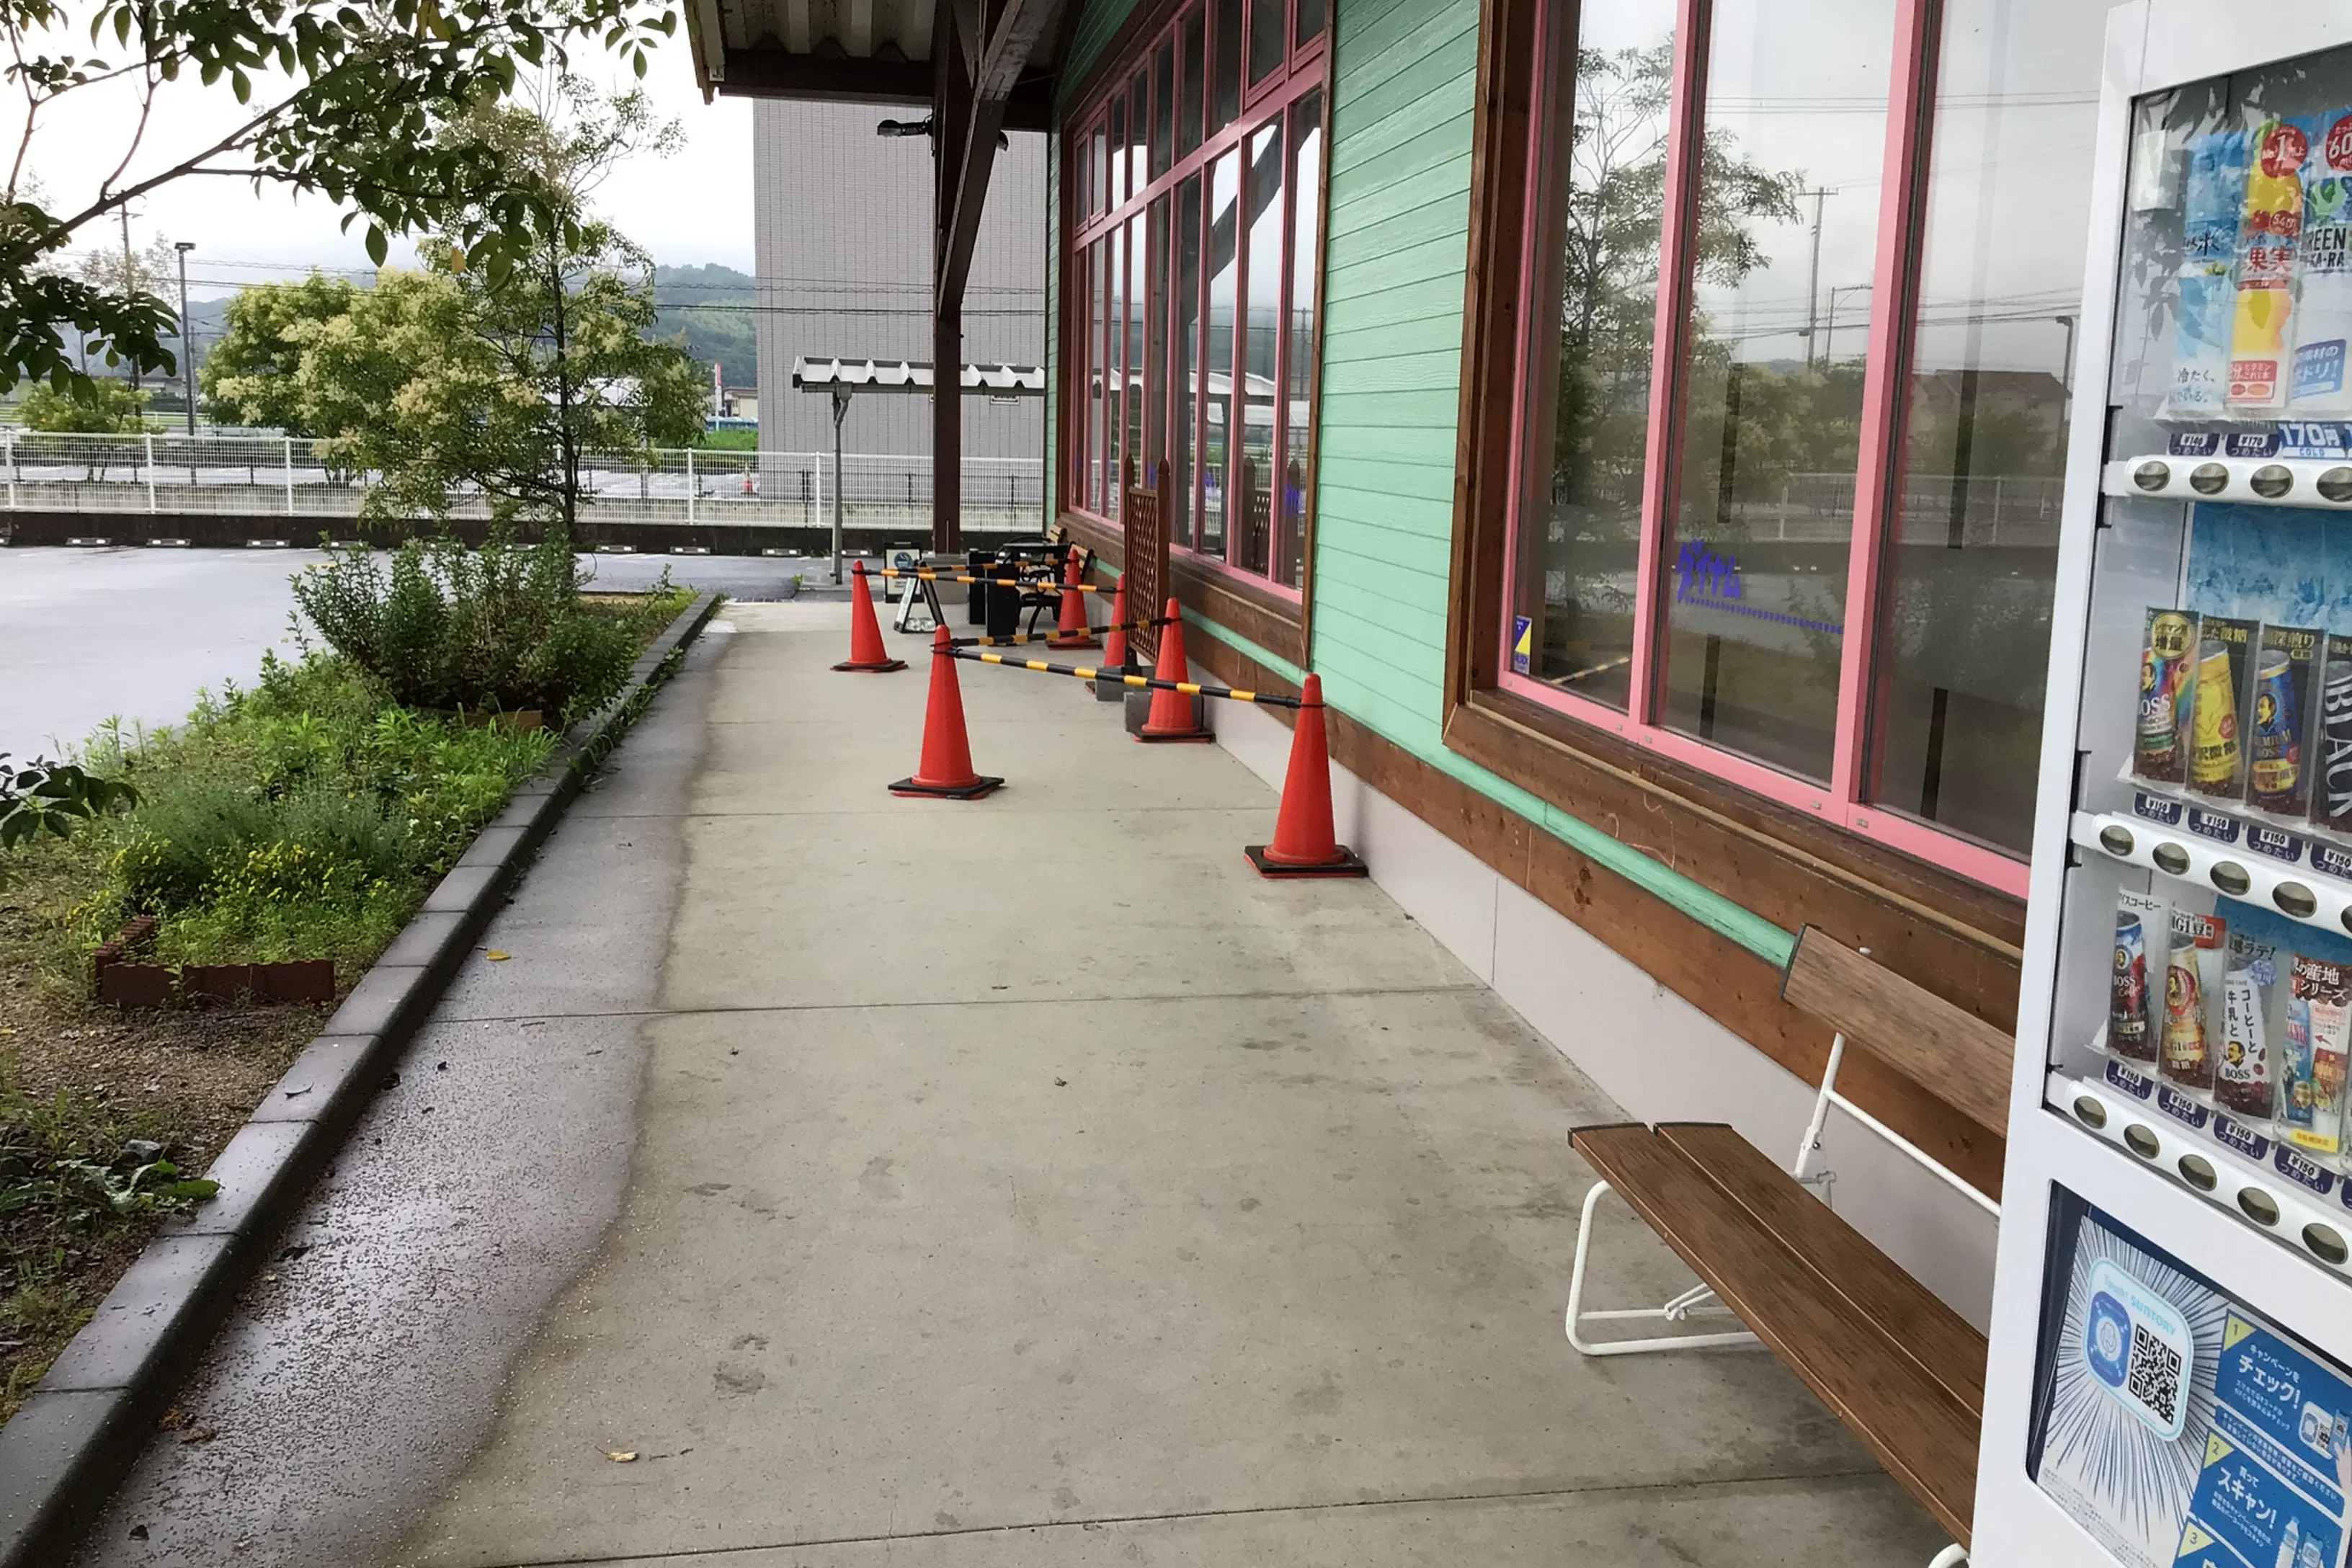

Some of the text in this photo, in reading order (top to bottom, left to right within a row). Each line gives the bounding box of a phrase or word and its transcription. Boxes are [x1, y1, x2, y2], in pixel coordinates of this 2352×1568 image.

[2241, 245, 2294, 272] 果実
[2177, 368, 2215, 384] 冷たく、
[2241, 436, 2263, 446] ¥170
[2277, 423, 2340, 446] 170円
[2173, 447, 2211, 455] つめたい
[2231, 447, 2272, 457] つめたい
[2140, 693, 2171, 716] OSS
[2150, 799, 2167, 811] ¥150
[2138, 806, 2175, 824] つめたい
[2207, 815, 2227, 829] ¥150
[2193, 823, 2232, 841] つめたい
[2263, 831, 2286, 845] ¥150
[2253, 841, 2294, 860] つめたい
[2328, 850, 2351, 868] ¥150
[2300, 980, 2350, 1001] シリーズ
[2227, 990, 2239, 1037] 牛乳と
[2242, 989, 2258, 1054] コーヒーと
[2121, 1066, 2140, 1084] ¥150
[2224, 1066, 2251, 1079] BOSS
[2111, 1074, 2145, 1098] つめたい
[2171, 1095, 2192, 1111] ¥150
[2162, 1102, 2199, 1126] つめたい
[2229, 1124, 2252, 1141] ¥150
[2219, 1131, 2259, 1158] つめたい
[2291, 1155, 2315, 1177] ¥150
[2281, 1162, 2325, 1192] つめたい
[2234, 1324, 2239, 1336] 1
[2250, 1344, 2301, 1384] キャンペーンを
[2238, 1353, 2302, 1410] チェック!
[2211, 1440, 2220, 1456] 2
[2217, 1466, 2278, 1530] スキャン!
[2189, 1531, 2199, 1545] 3
